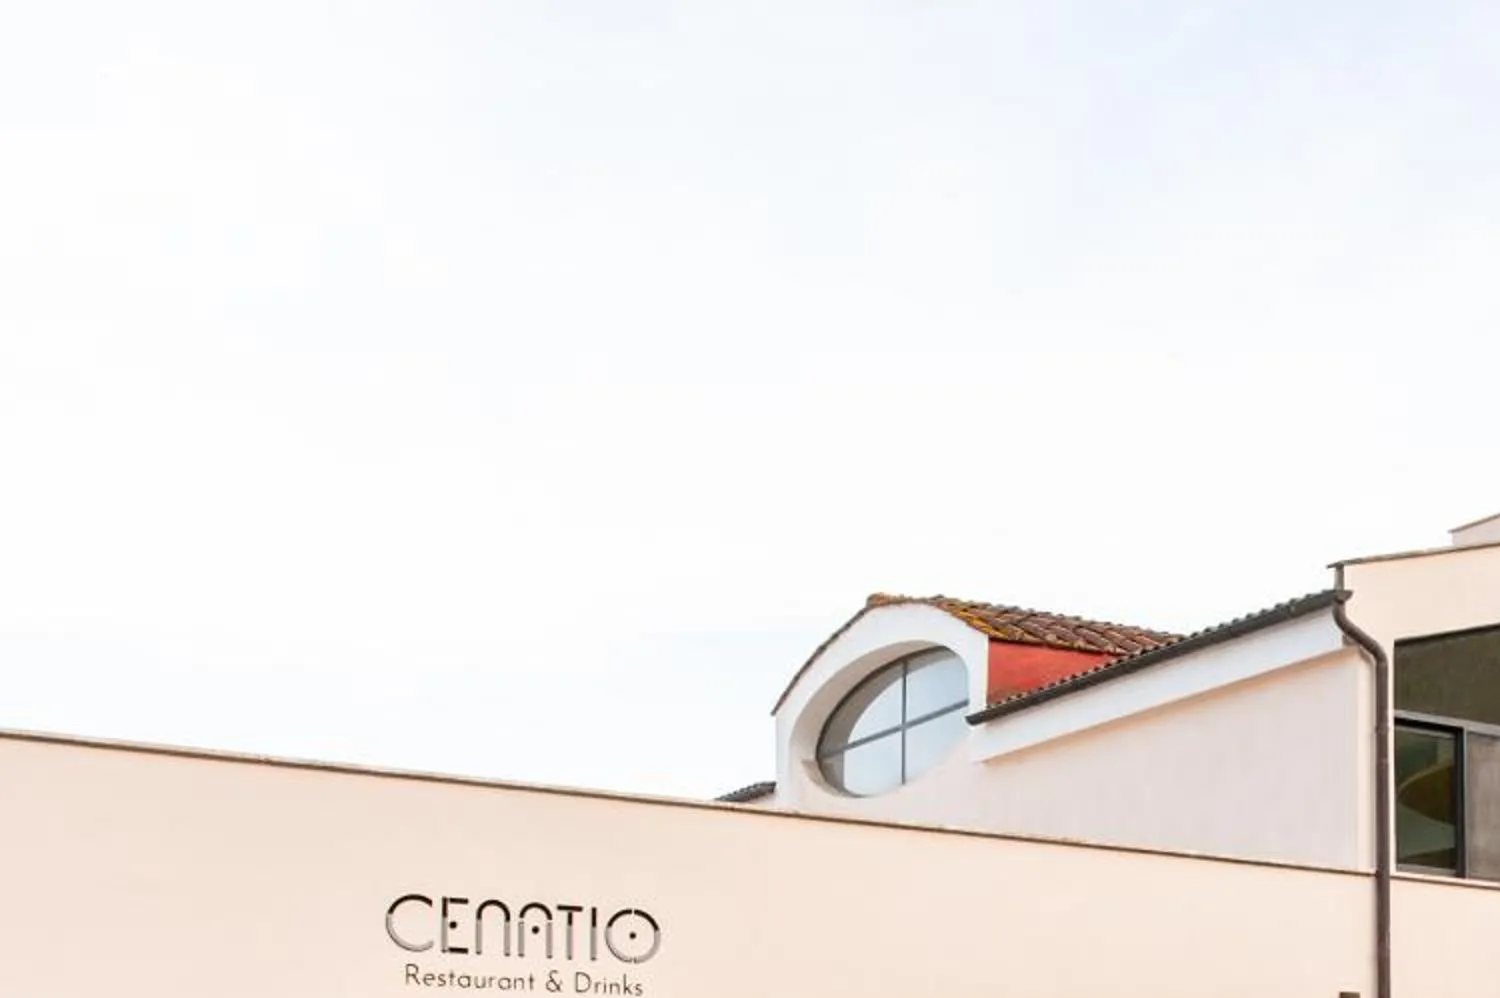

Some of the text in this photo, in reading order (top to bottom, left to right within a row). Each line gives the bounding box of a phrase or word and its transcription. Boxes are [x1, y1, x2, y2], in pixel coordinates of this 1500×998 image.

[385, 893, 662, 964] CENATIO
[404, 962, 644, 997] Restaurant & Drinks
